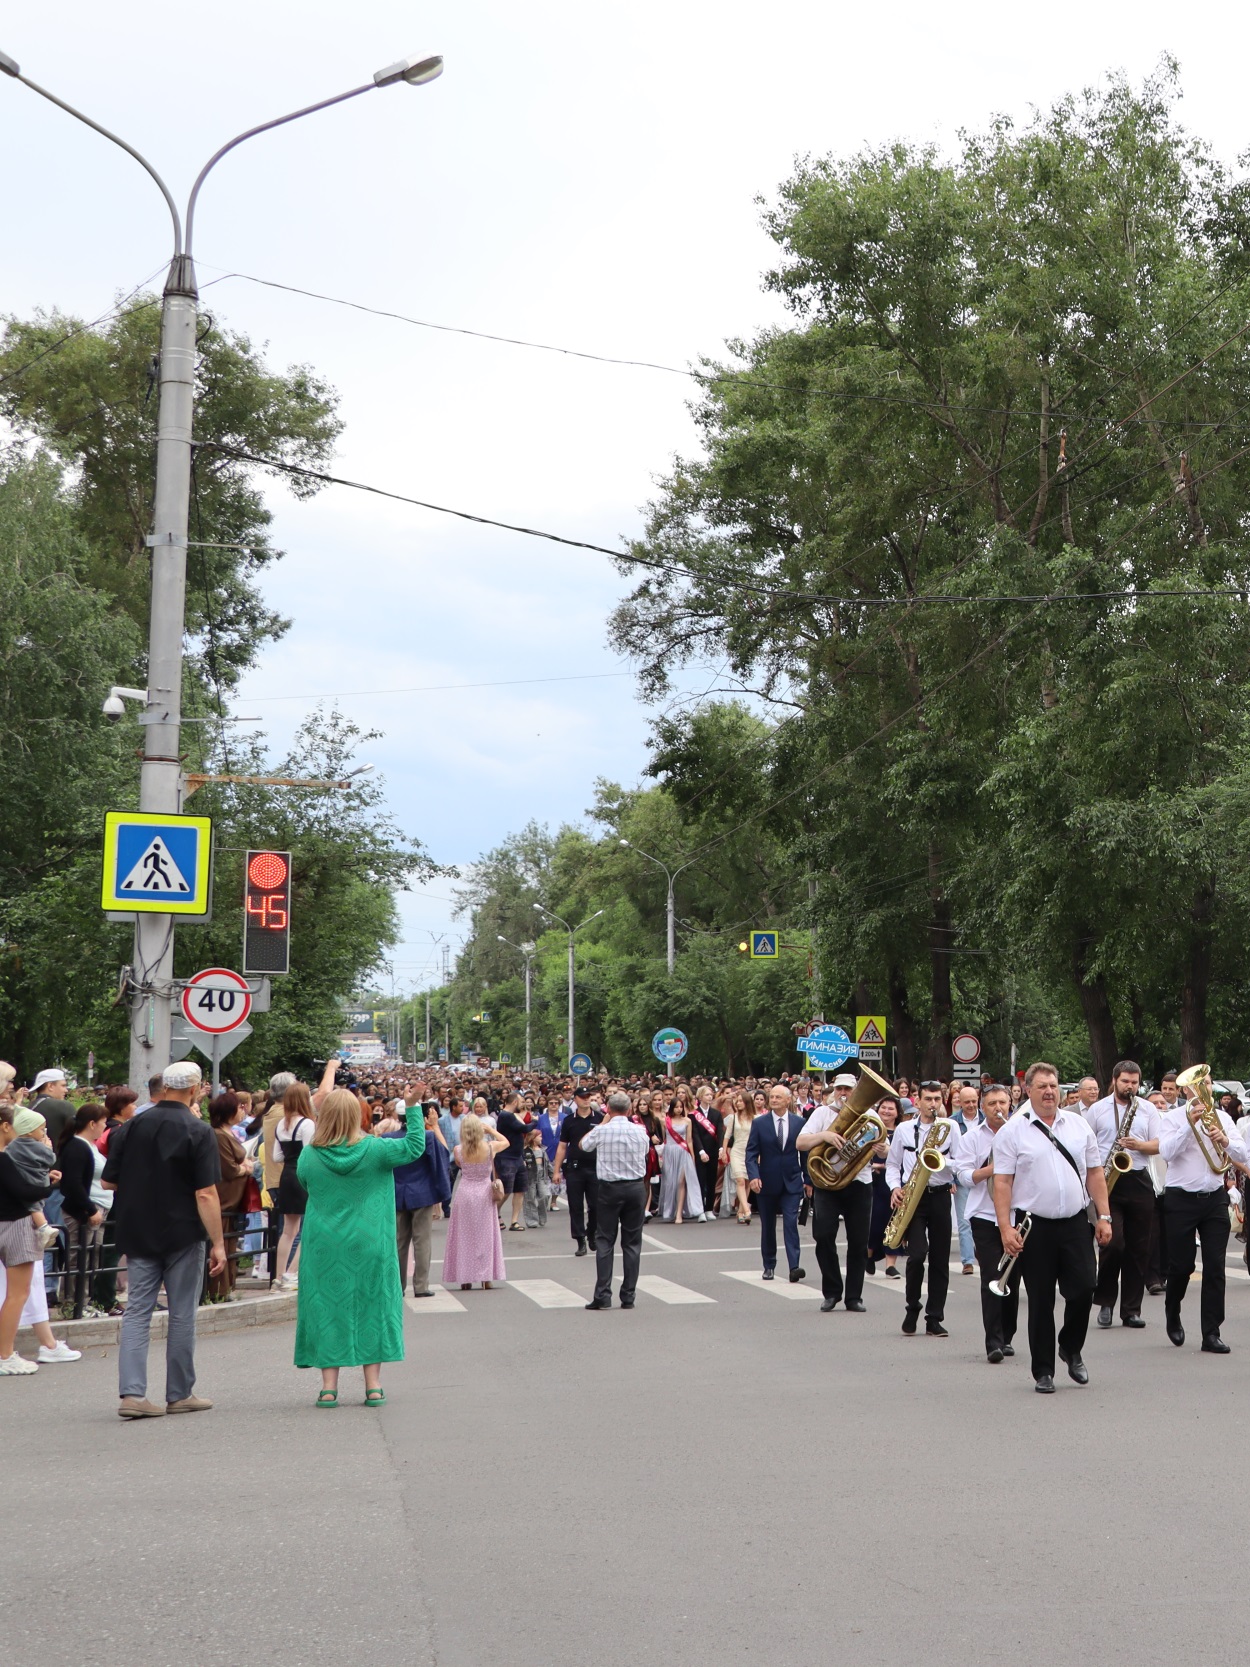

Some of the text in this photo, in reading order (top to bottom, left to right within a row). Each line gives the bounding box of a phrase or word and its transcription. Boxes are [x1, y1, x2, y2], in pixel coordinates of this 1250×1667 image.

[247, 895, 287, 928] 45
[198, 989, 235, 1012] 40
[814, 1026, 847, 1040] АБАКАН
[799, 1040, 858, 1055] ГИМНАЗИЯ
[810, 1055, 843, 1068] ХАКАСИЯ
